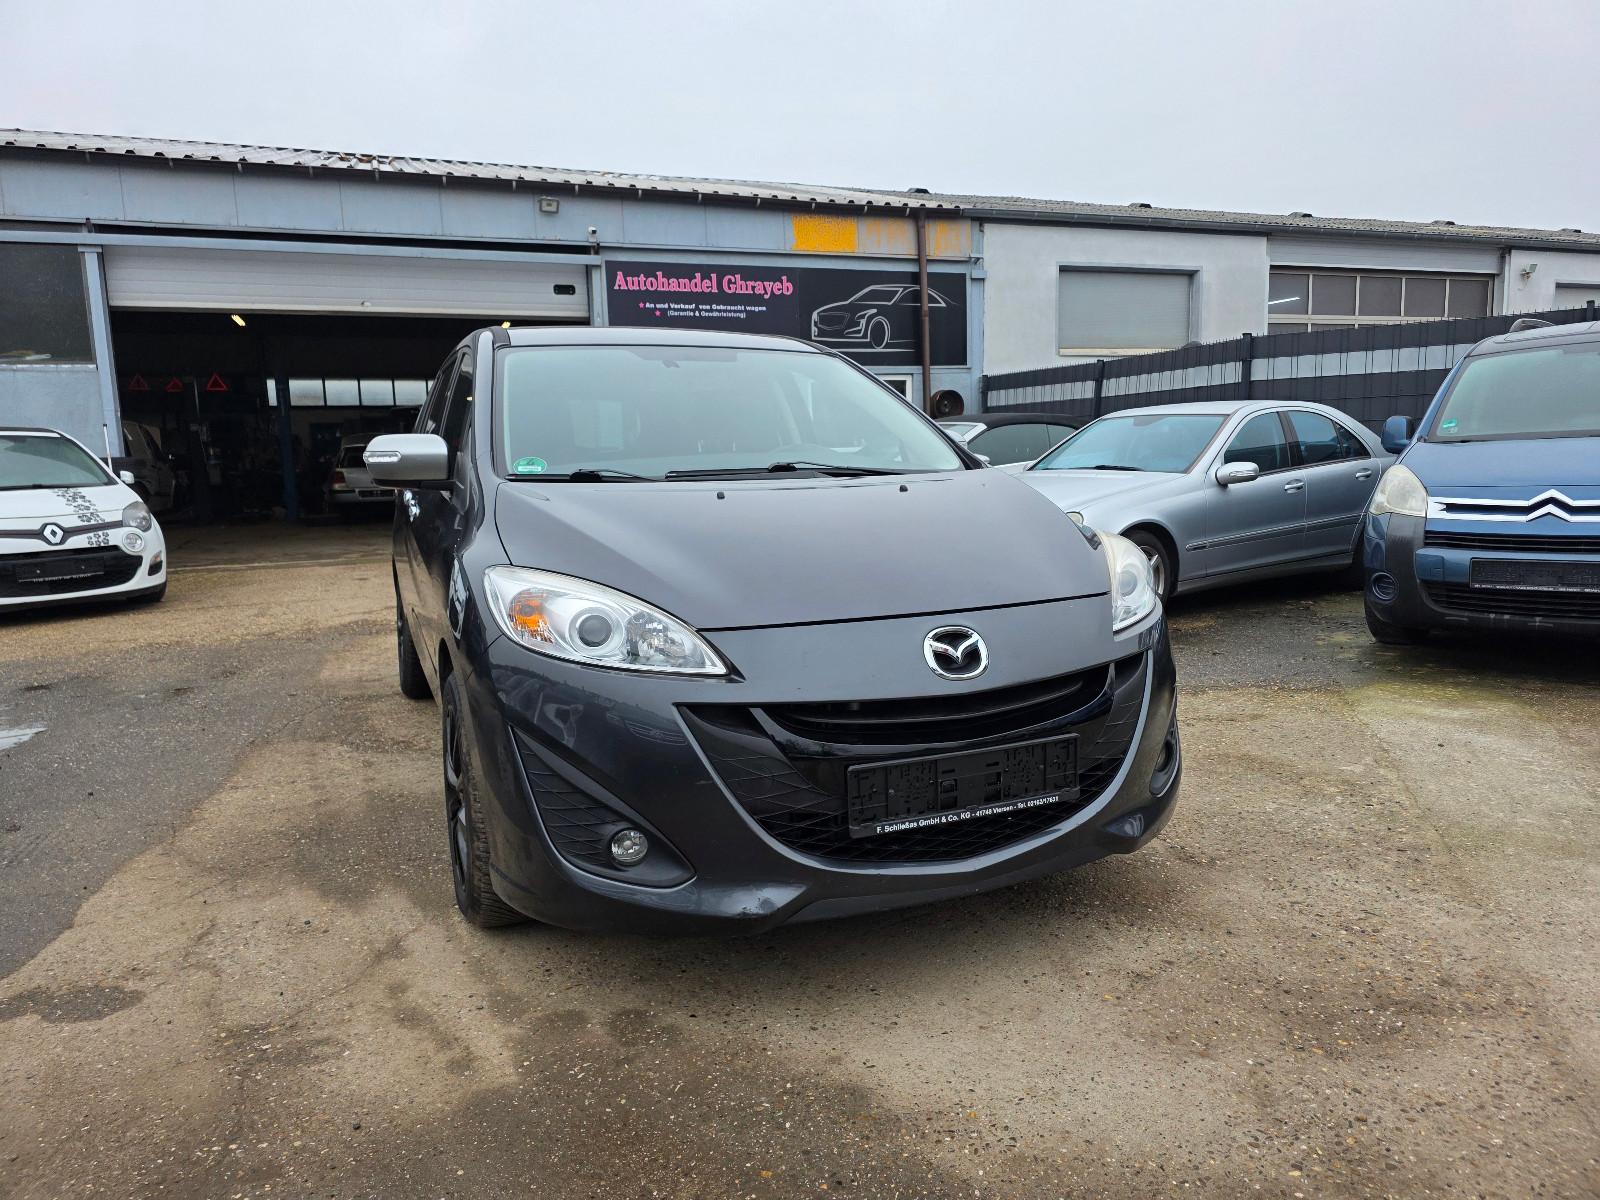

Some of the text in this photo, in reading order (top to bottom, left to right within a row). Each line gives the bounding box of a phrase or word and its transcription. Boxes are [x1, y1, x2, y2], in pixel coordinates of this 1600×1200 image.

[613, 271, 793, 299] Autohandel Ghrayeb
[876, 826, 883, 834] F.
[919, 817, 940, 827] GmbH
[947, 814, 959, 822] Co.
[960, 811, 971, 819] KG
[992, 805, 1014, 814] Viersen
